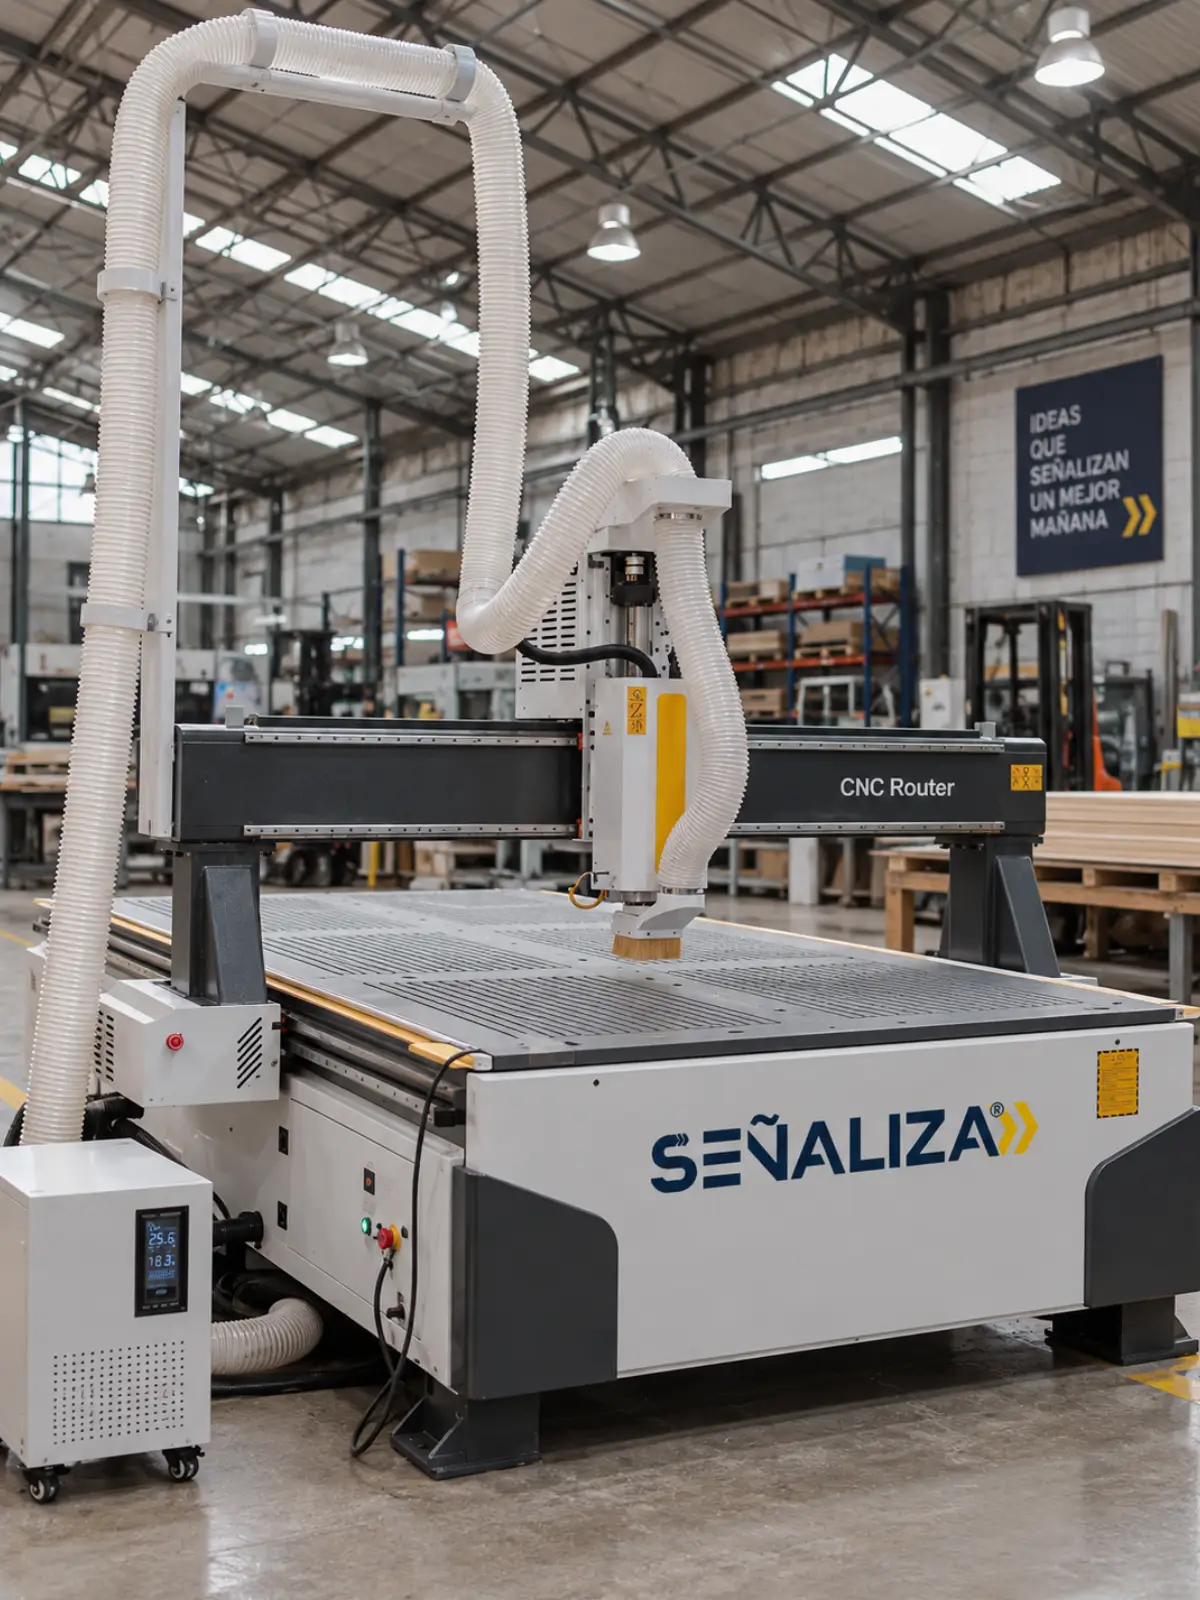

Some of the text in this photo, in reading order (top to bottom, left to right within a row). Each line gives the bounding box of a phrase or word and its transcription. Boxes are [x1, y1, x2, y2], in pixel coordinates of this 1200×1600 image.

[1029, 404, 1081, 434] IDEAS
[1029, 434, 1066, 460] QUE
[1029, 449, 1130, 486] SEÑALIZAN
[1029, 479, 1120, 512] UN MEJOR
[1029, 509, 1109, 538] MAÑANA
[840, 777, 955, 796] CNC Router
